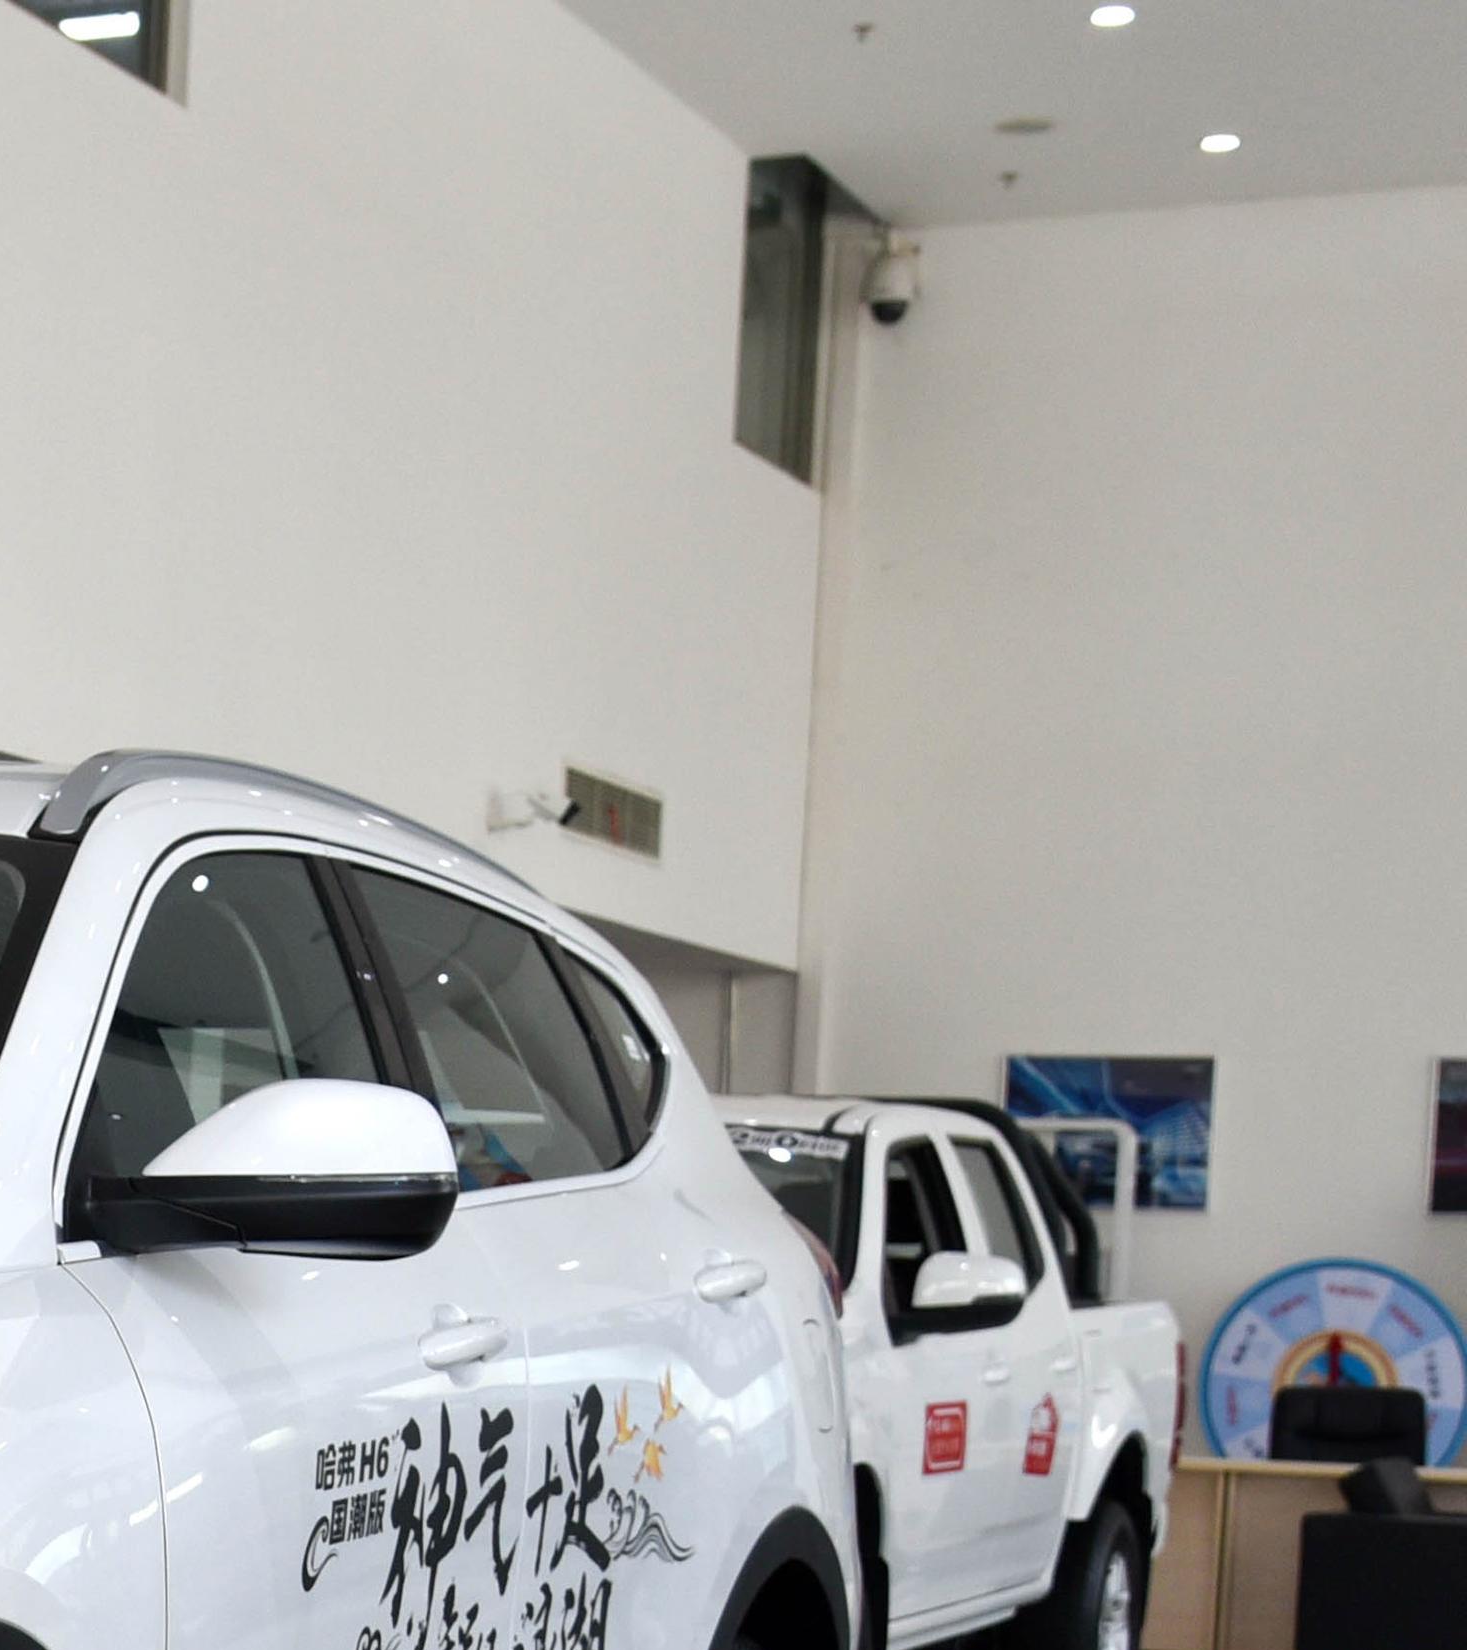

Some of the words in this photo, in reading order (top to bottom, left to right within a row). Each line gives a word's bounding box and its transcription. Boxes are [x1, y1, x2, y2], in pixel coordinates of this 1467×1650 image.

[315, 1441, 356, 1491] 哈弗
[359, 1437, 389, 1483] H6
[329, 1488, 386, 1545] 国潮版
